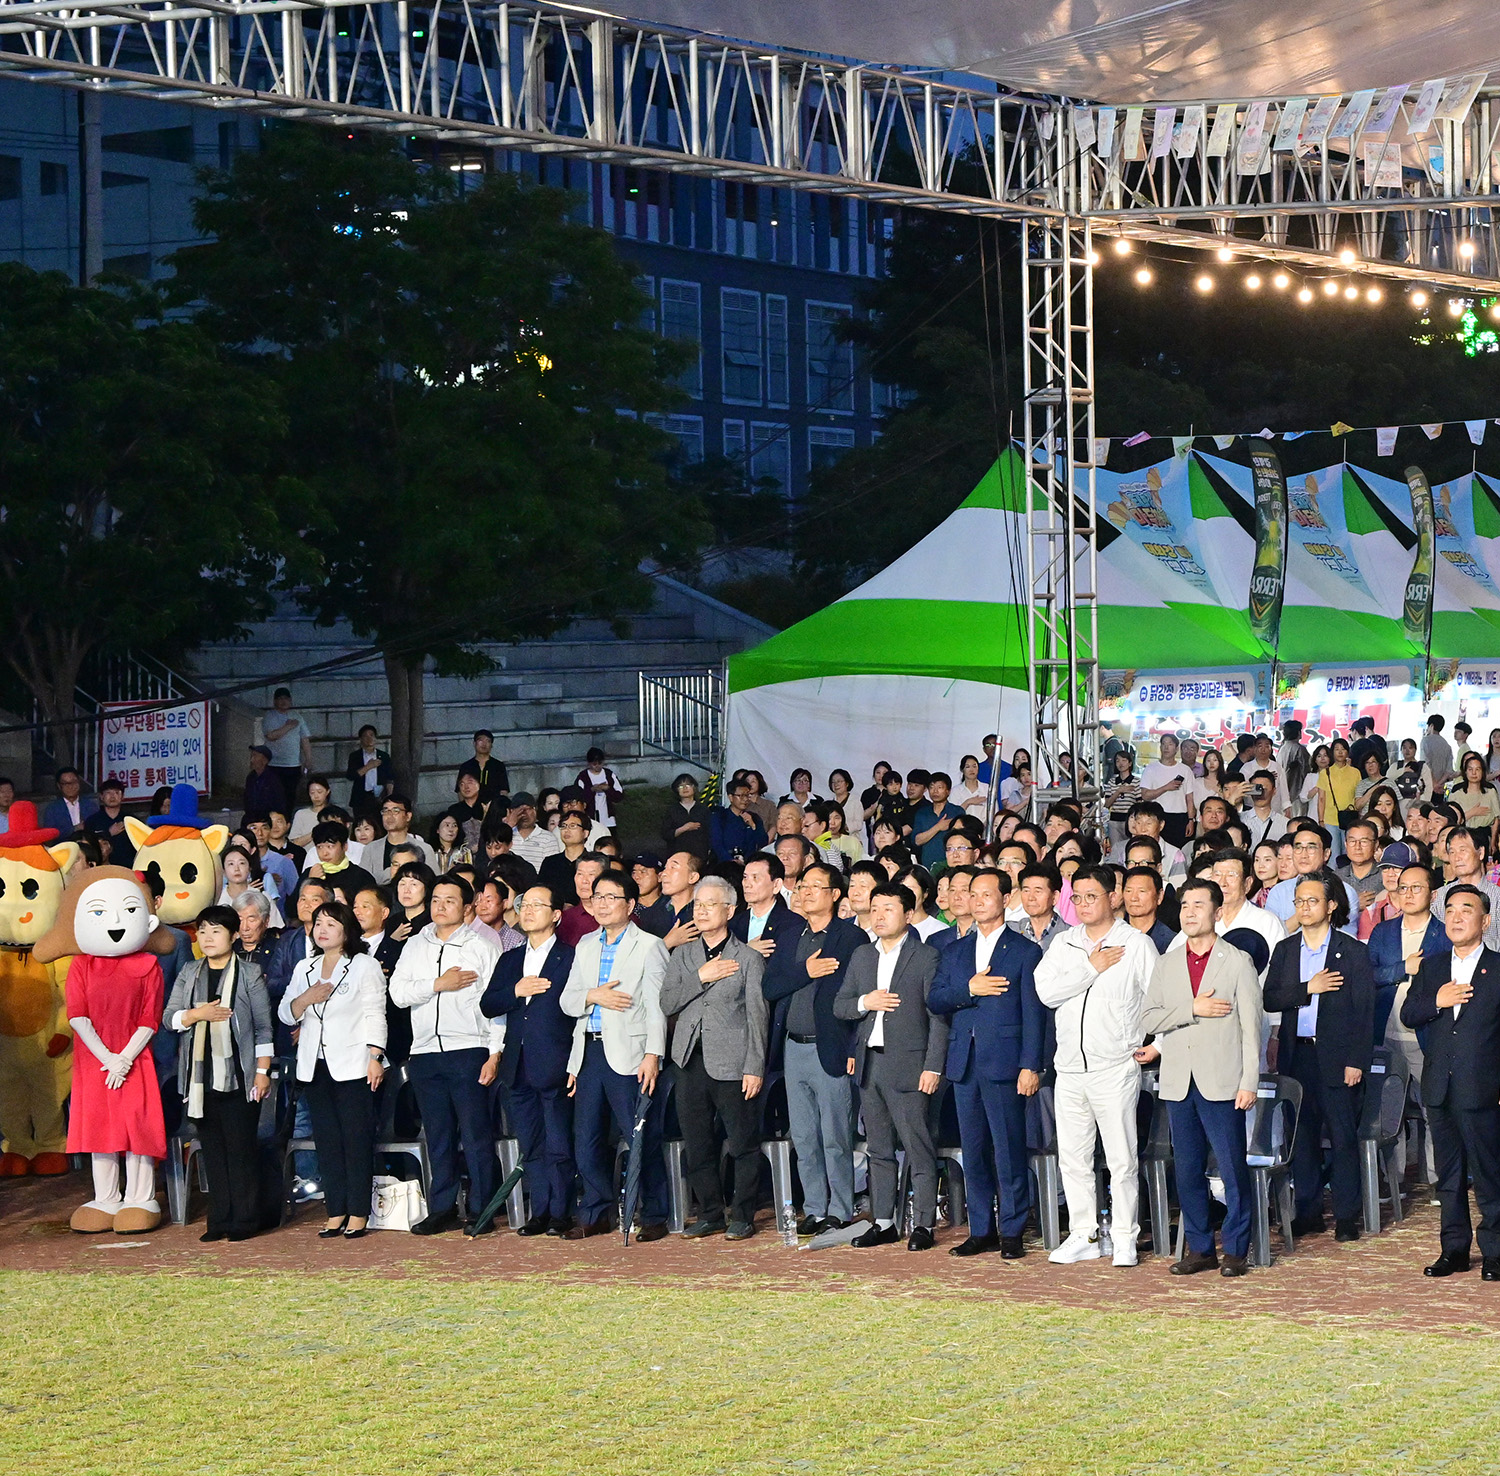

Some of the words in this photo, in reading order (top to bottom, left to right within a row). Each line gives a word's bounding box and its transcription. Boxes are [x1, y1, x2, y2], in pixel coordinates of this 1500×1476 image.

[1150, 683, 1175, 702] 닭강정
[1178, 681, 1224, 701] 경주황리단길
[1358, 673, 1391, 690] 회오리감자
[124, 711, 188, 733] 무단횡단으로
[107, 742, 127, 761] 인한
[130, 739, 179, 760] 사고위험이
[182, 737, 202, 756] 있어
[144, 764, 201, 787] 통제합니다.
